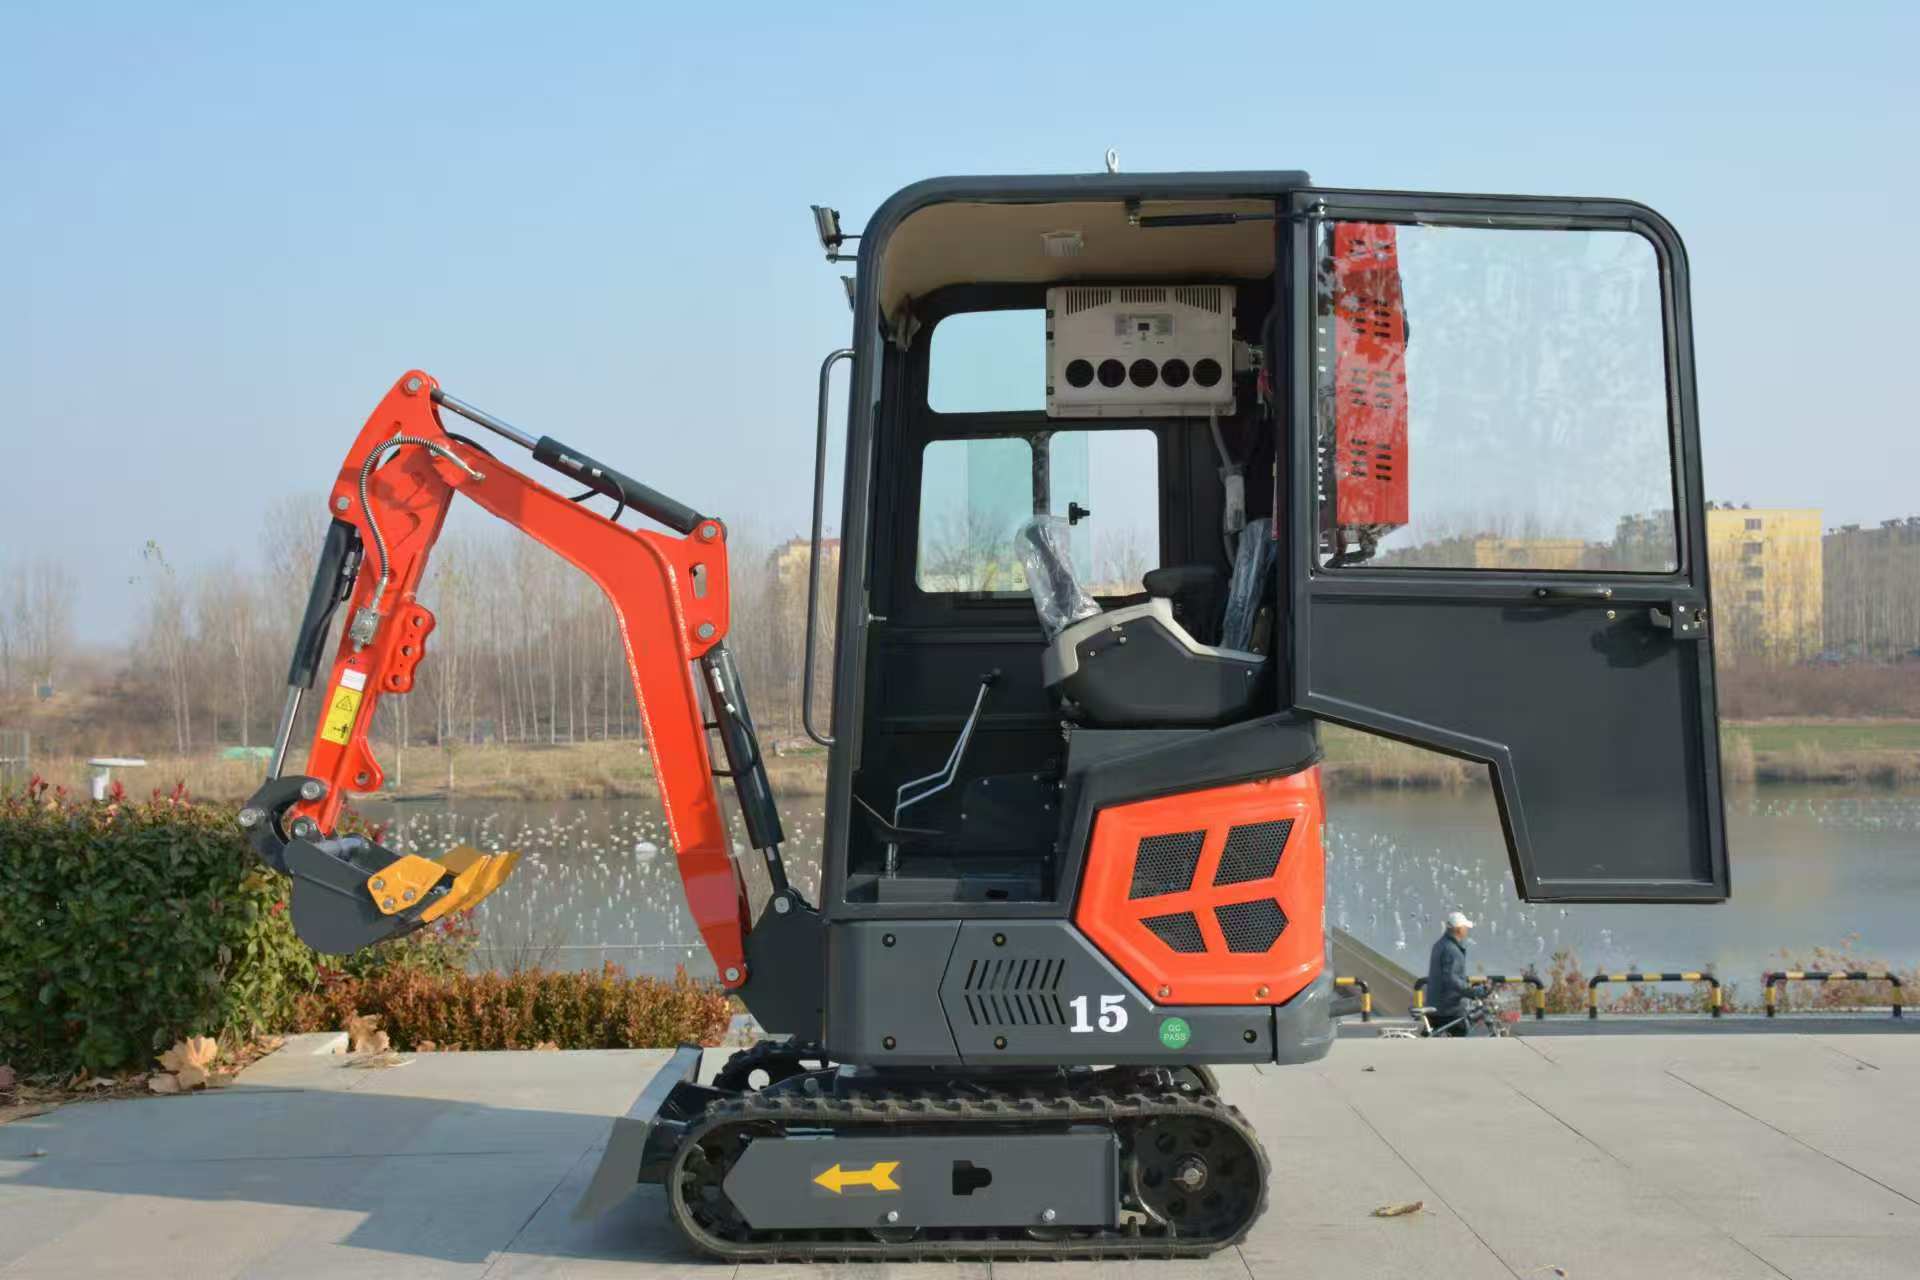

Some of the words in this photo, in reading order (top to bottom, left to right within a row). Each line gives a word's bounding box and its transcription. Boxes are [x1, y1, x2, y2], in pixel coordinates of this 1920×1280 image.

[1069, 994, 1128, 1033] 15
[1168, 1024, 1181, 1032] QC
[1163, 1033, 1186, 1041] PASS
